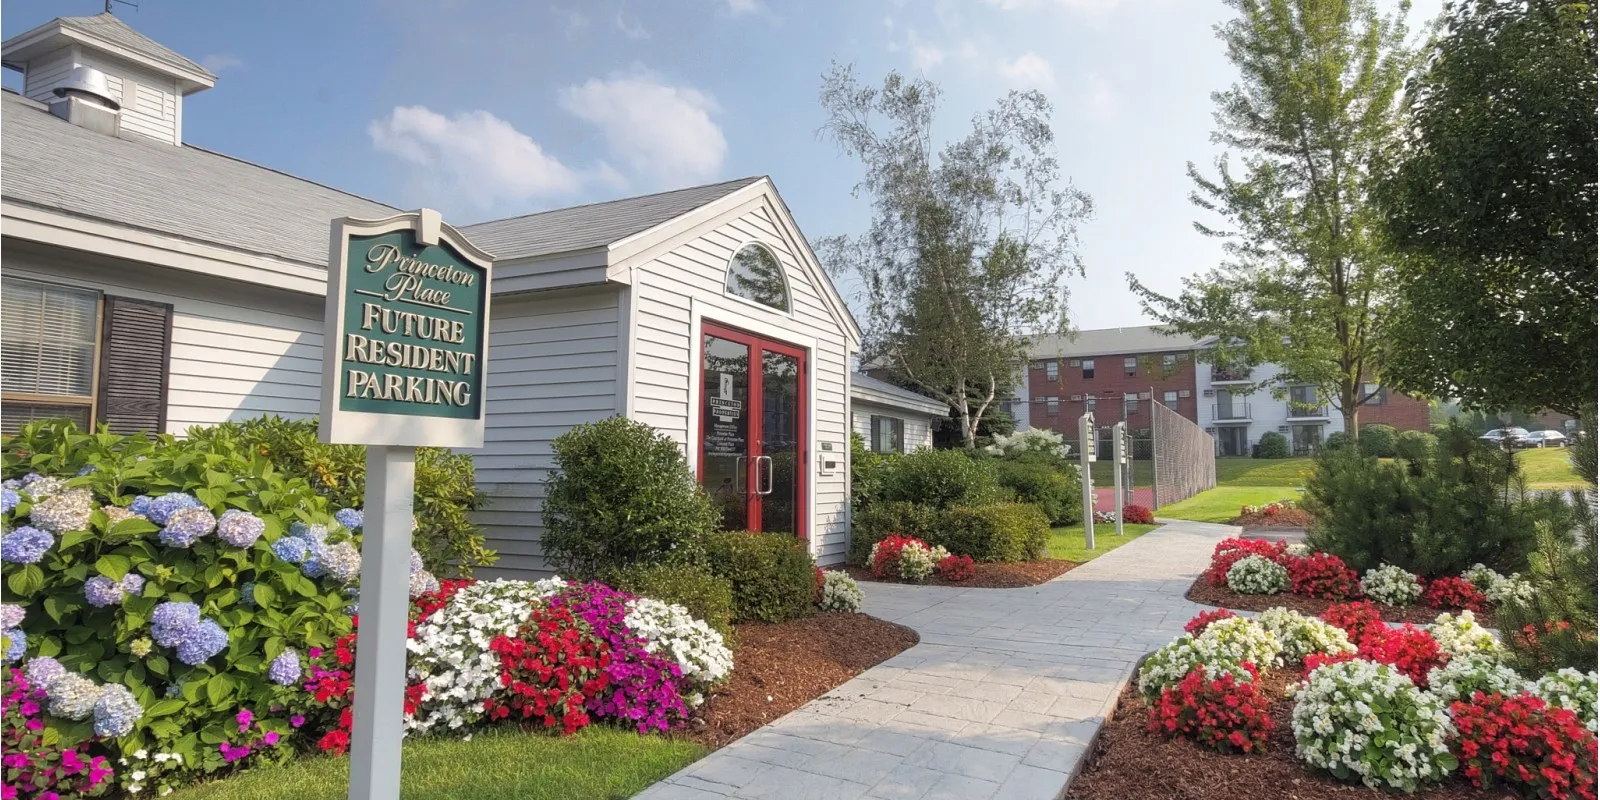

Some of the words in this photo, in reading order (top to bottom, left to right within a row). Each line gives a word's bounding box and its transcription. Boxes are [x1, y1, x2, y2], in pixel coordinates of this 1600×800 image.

[366, 243, 475, 287] Princeton
[384, 272, 451, 305] Place
[361, 302, 465, 344] FUTURE
[345, 333, 476, 375] RESIDENT
[346, 369, 472, 406] PARKING
